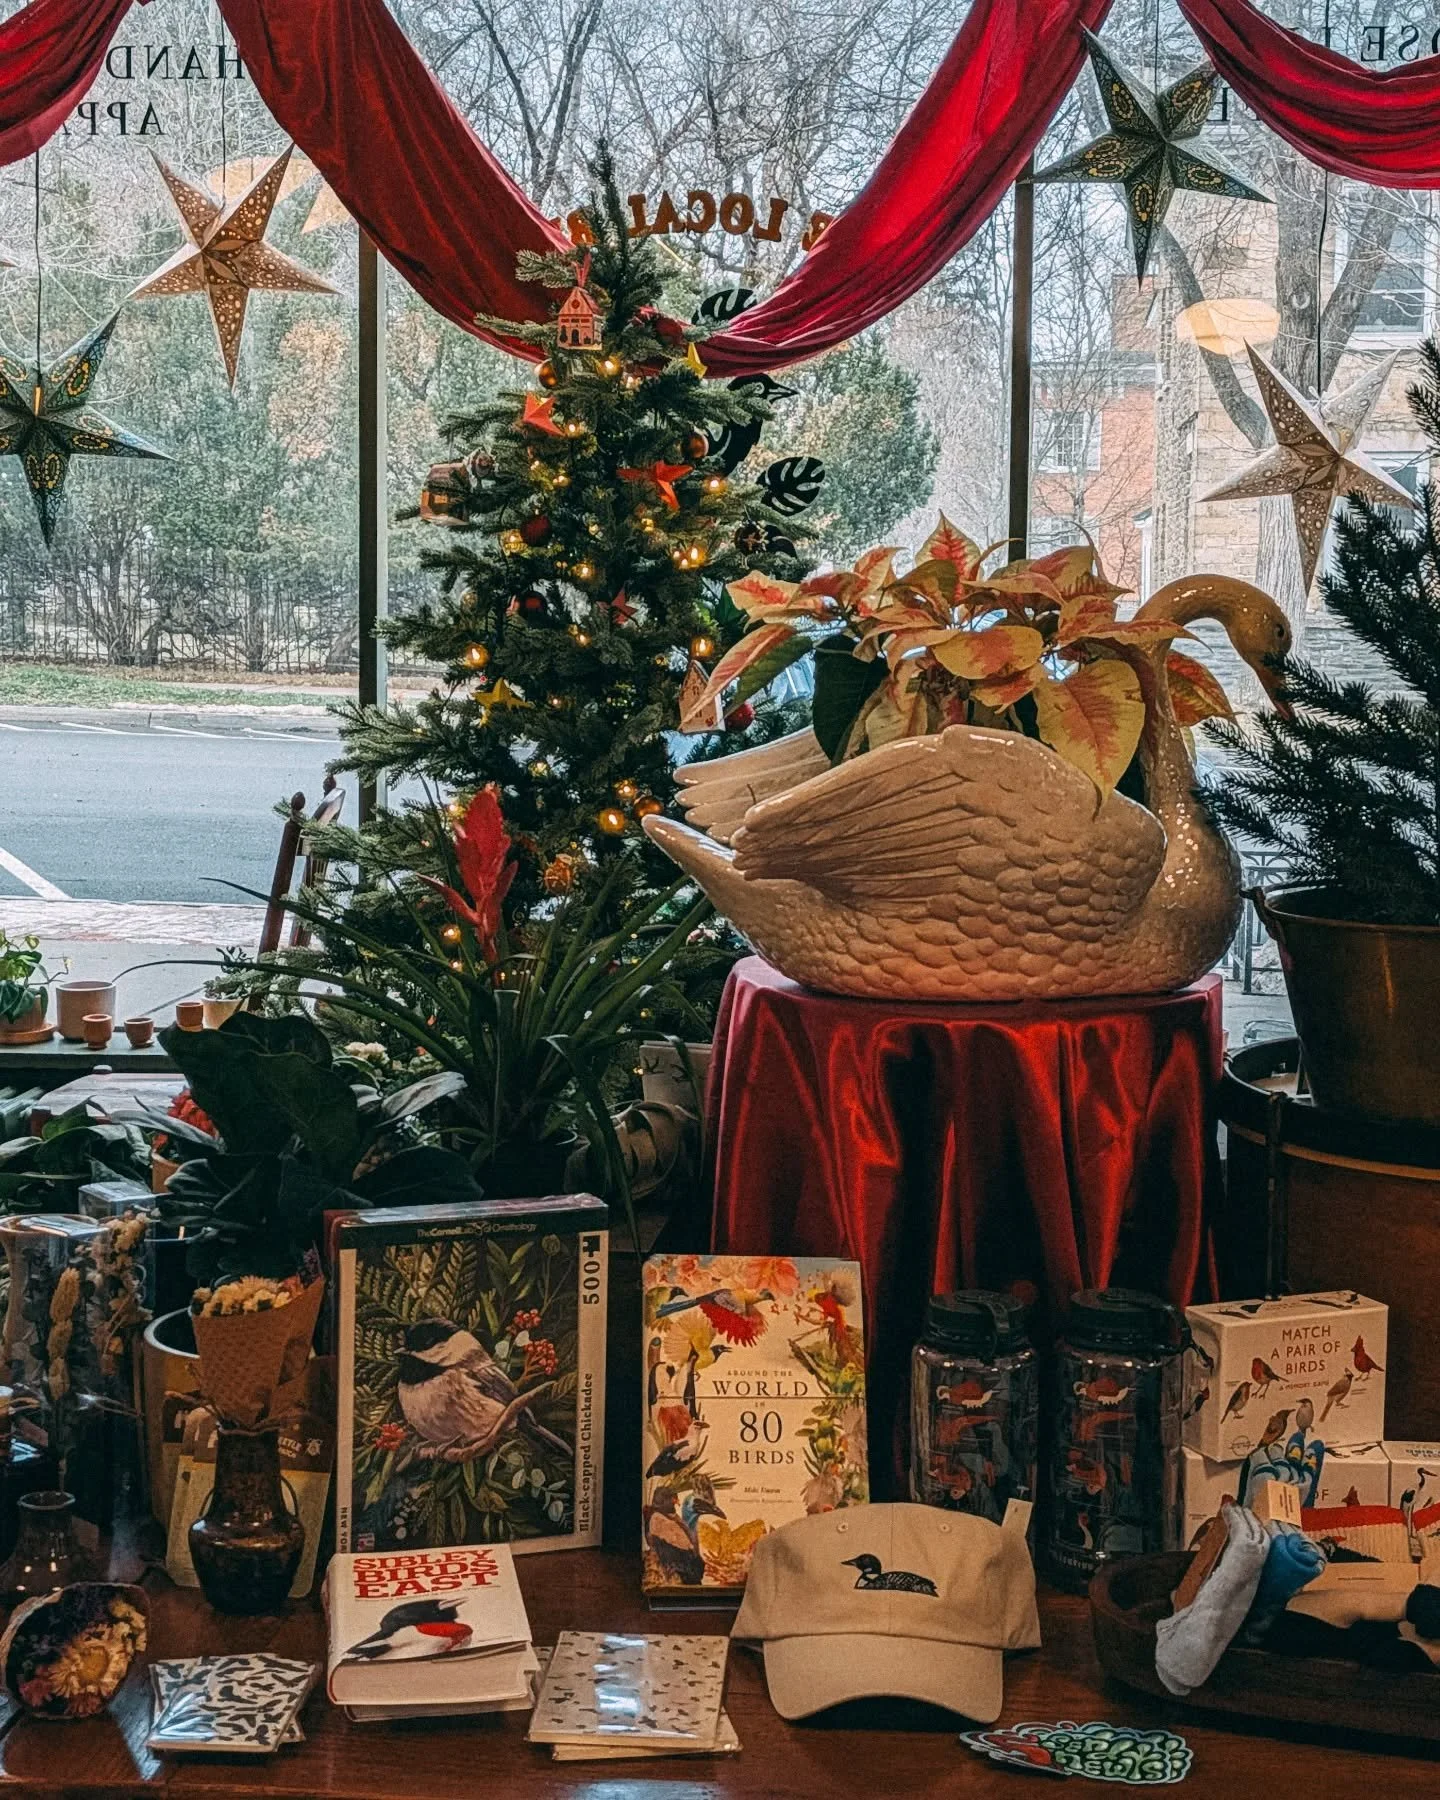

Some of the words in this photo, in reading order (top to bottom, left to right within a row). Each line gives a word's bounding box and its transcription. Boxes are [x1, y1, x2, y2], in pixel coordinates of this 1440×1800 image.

[583, 1260, 601, 1306] 500
[1282, 1324, 1331, 1342] MATCH
[1270, 1347, 1280, 1360] A
[1286, 1343, 1316, 1359] PAIR
[1322, 1340, 1341, 1354] OF
[1285, 1359, 1326, 1376] BIRDS
[712, 1380, 809, 1397] WORLD
[580, 1373, 593, 1442] Chickadee
[739, 1410, 783, 1444] 80
[728, 1449, 795, 1465] BIRDS
[579, 1444, 593, 1532] Black-capped
[340, 1531, 348, 1554] YOR
[353, 1549, 494, 1570] SIBLEY
[353, 1558, 499, 1583] BIRDS
[354, 1570, 499, 1599] EAST
